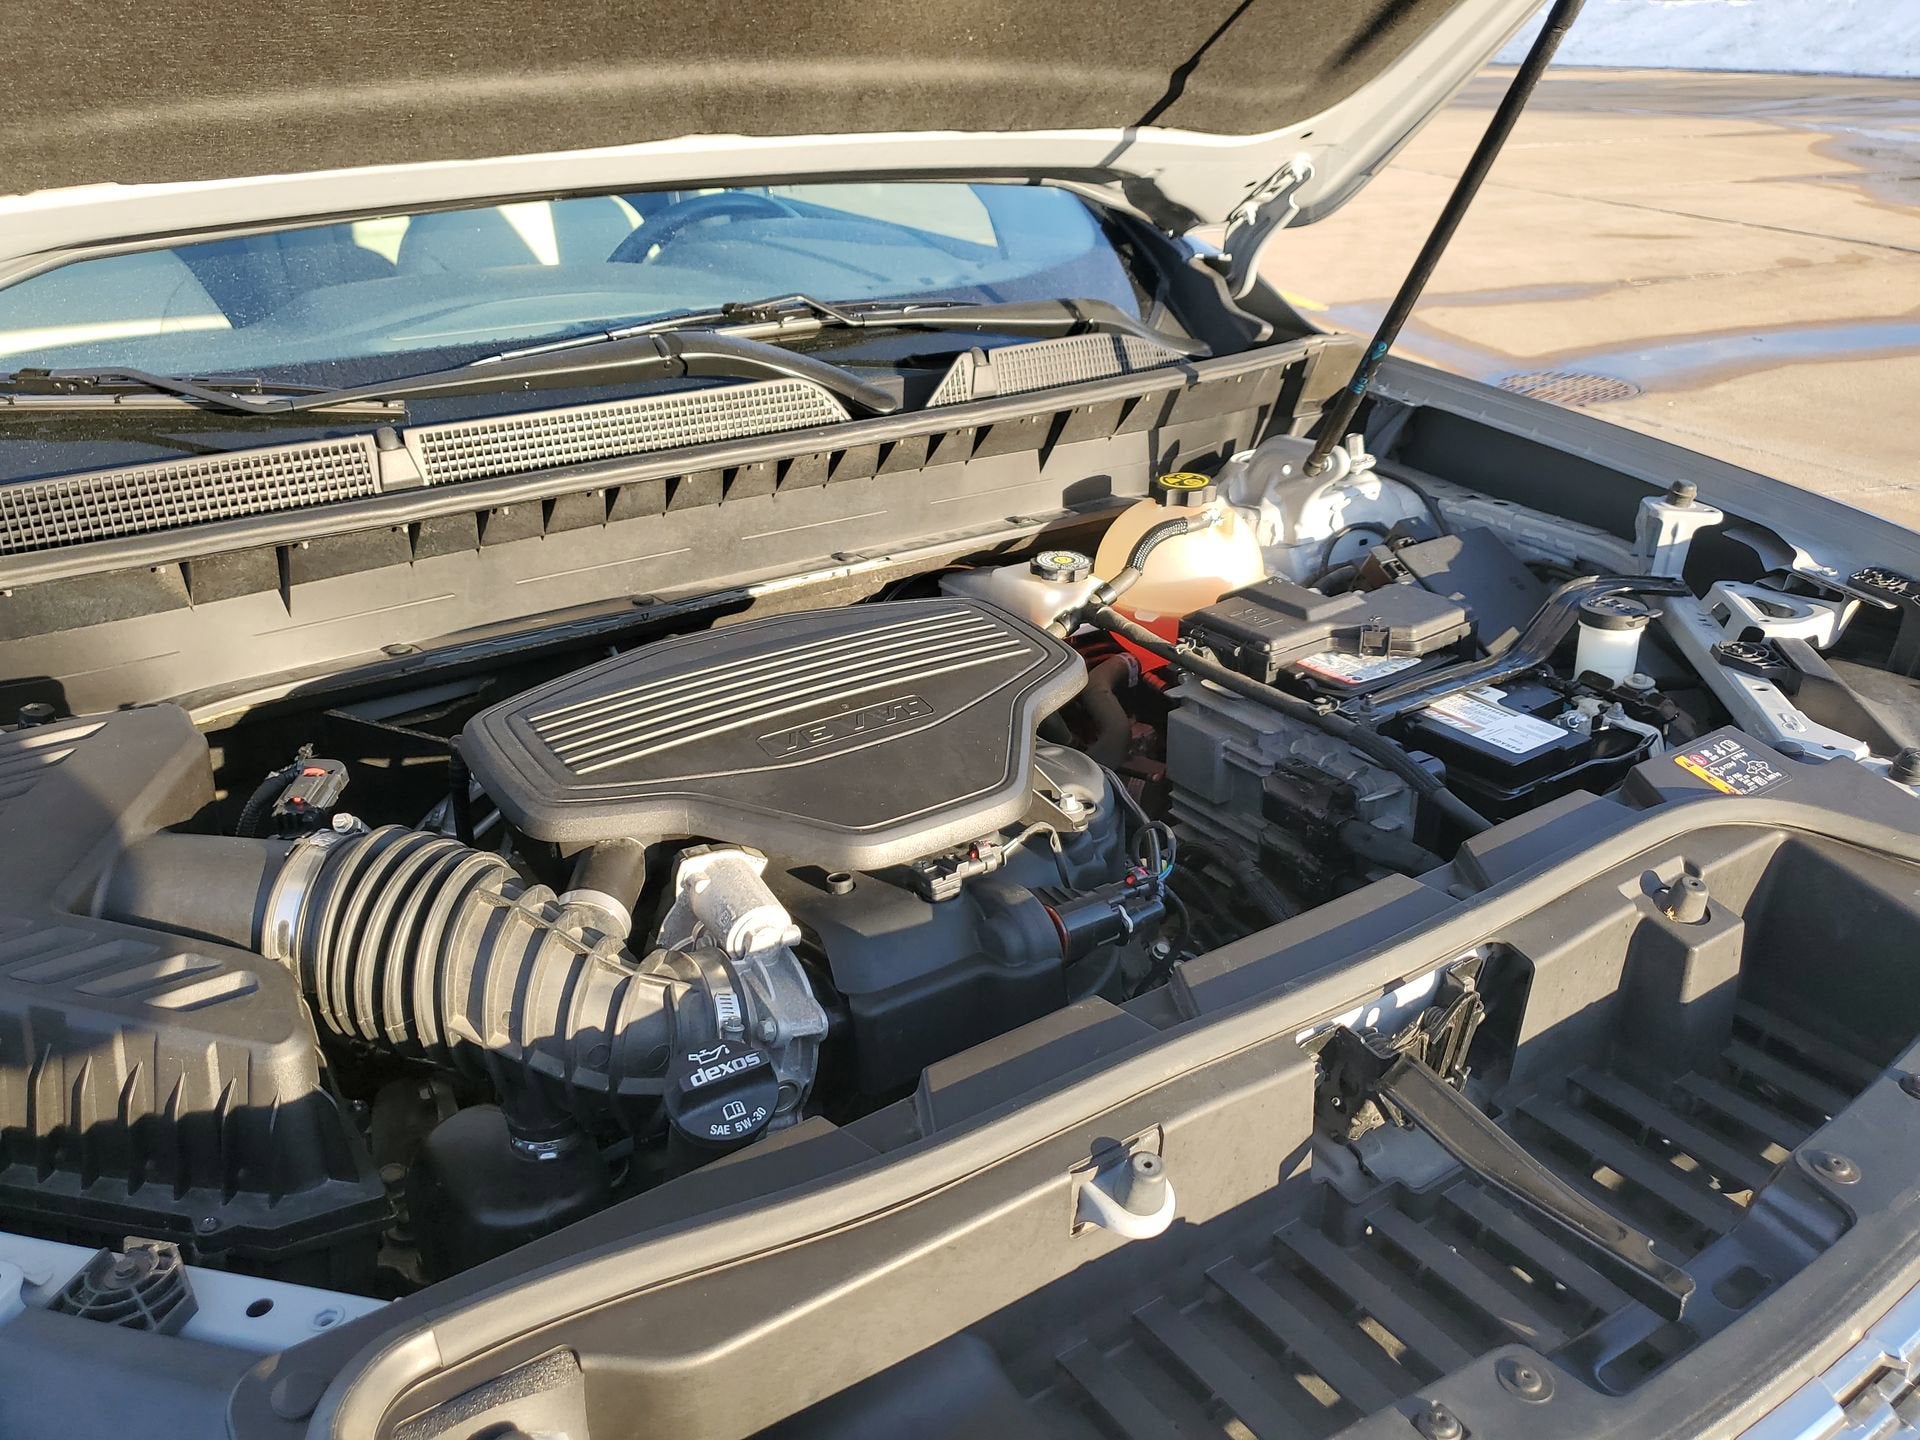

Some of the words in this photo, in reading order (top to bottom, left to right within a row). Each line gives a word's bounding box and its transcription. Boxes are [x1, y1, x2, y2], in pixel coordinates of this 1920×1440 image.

[690, 1052, 761, 1087] dexos
[709, 1124, 731, 1136] SAE
[735, 1106, 767, 1133] 5W-30
